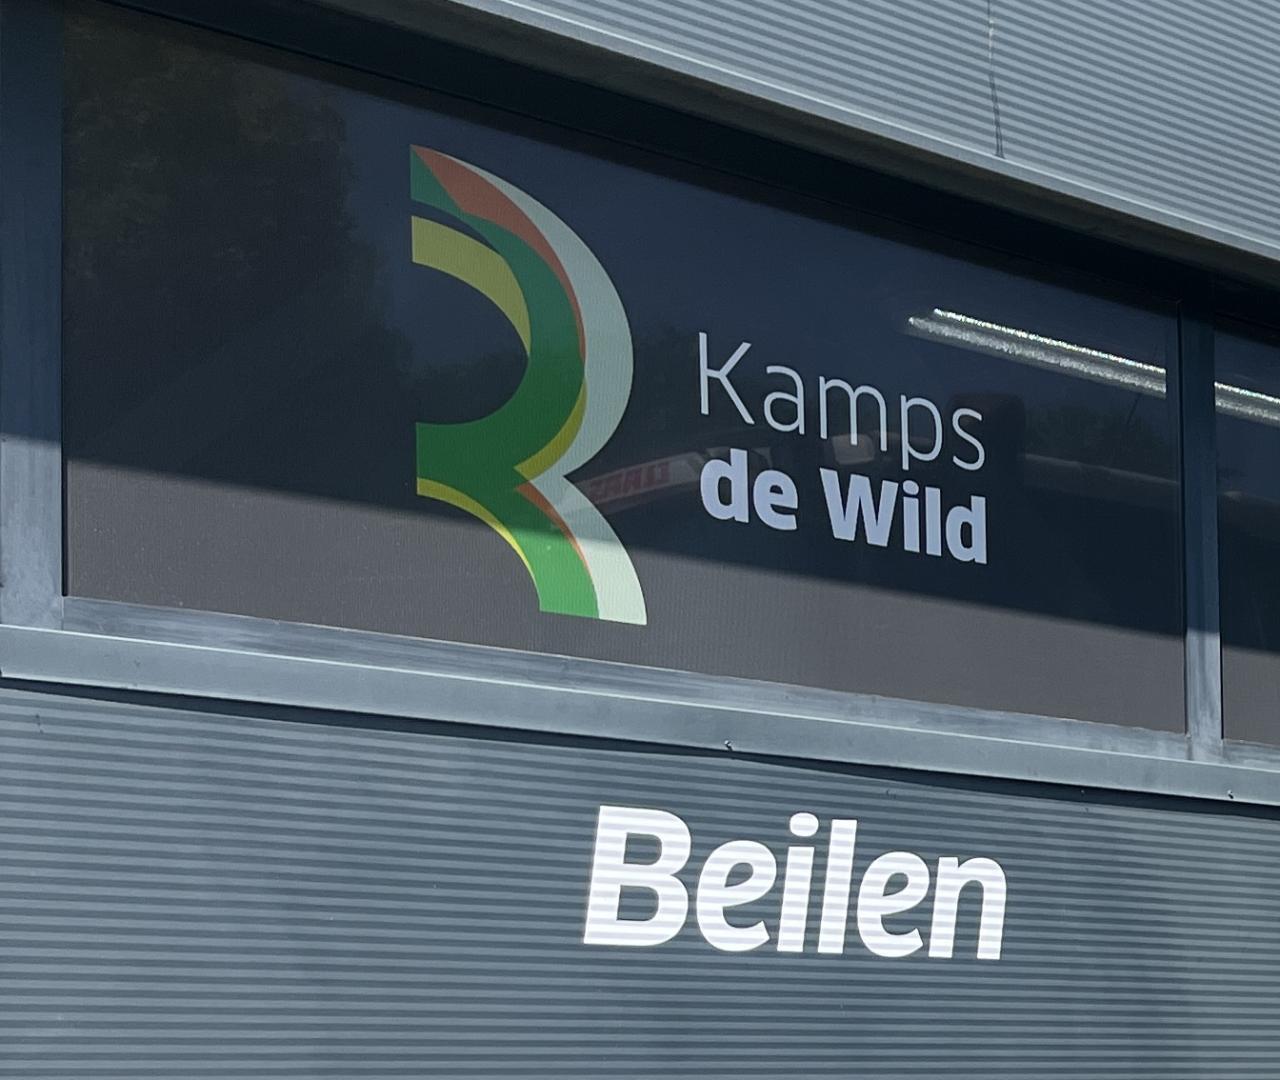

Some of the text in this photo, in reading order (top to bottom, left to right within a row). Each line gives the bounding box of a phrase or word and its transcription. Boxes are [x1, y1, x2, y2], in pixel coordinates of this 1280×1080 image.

[699, 332, 986, 471] Kamps
[699, 449, 987, 565] de Wild
[583, 805, 1008, 959] Beilen
